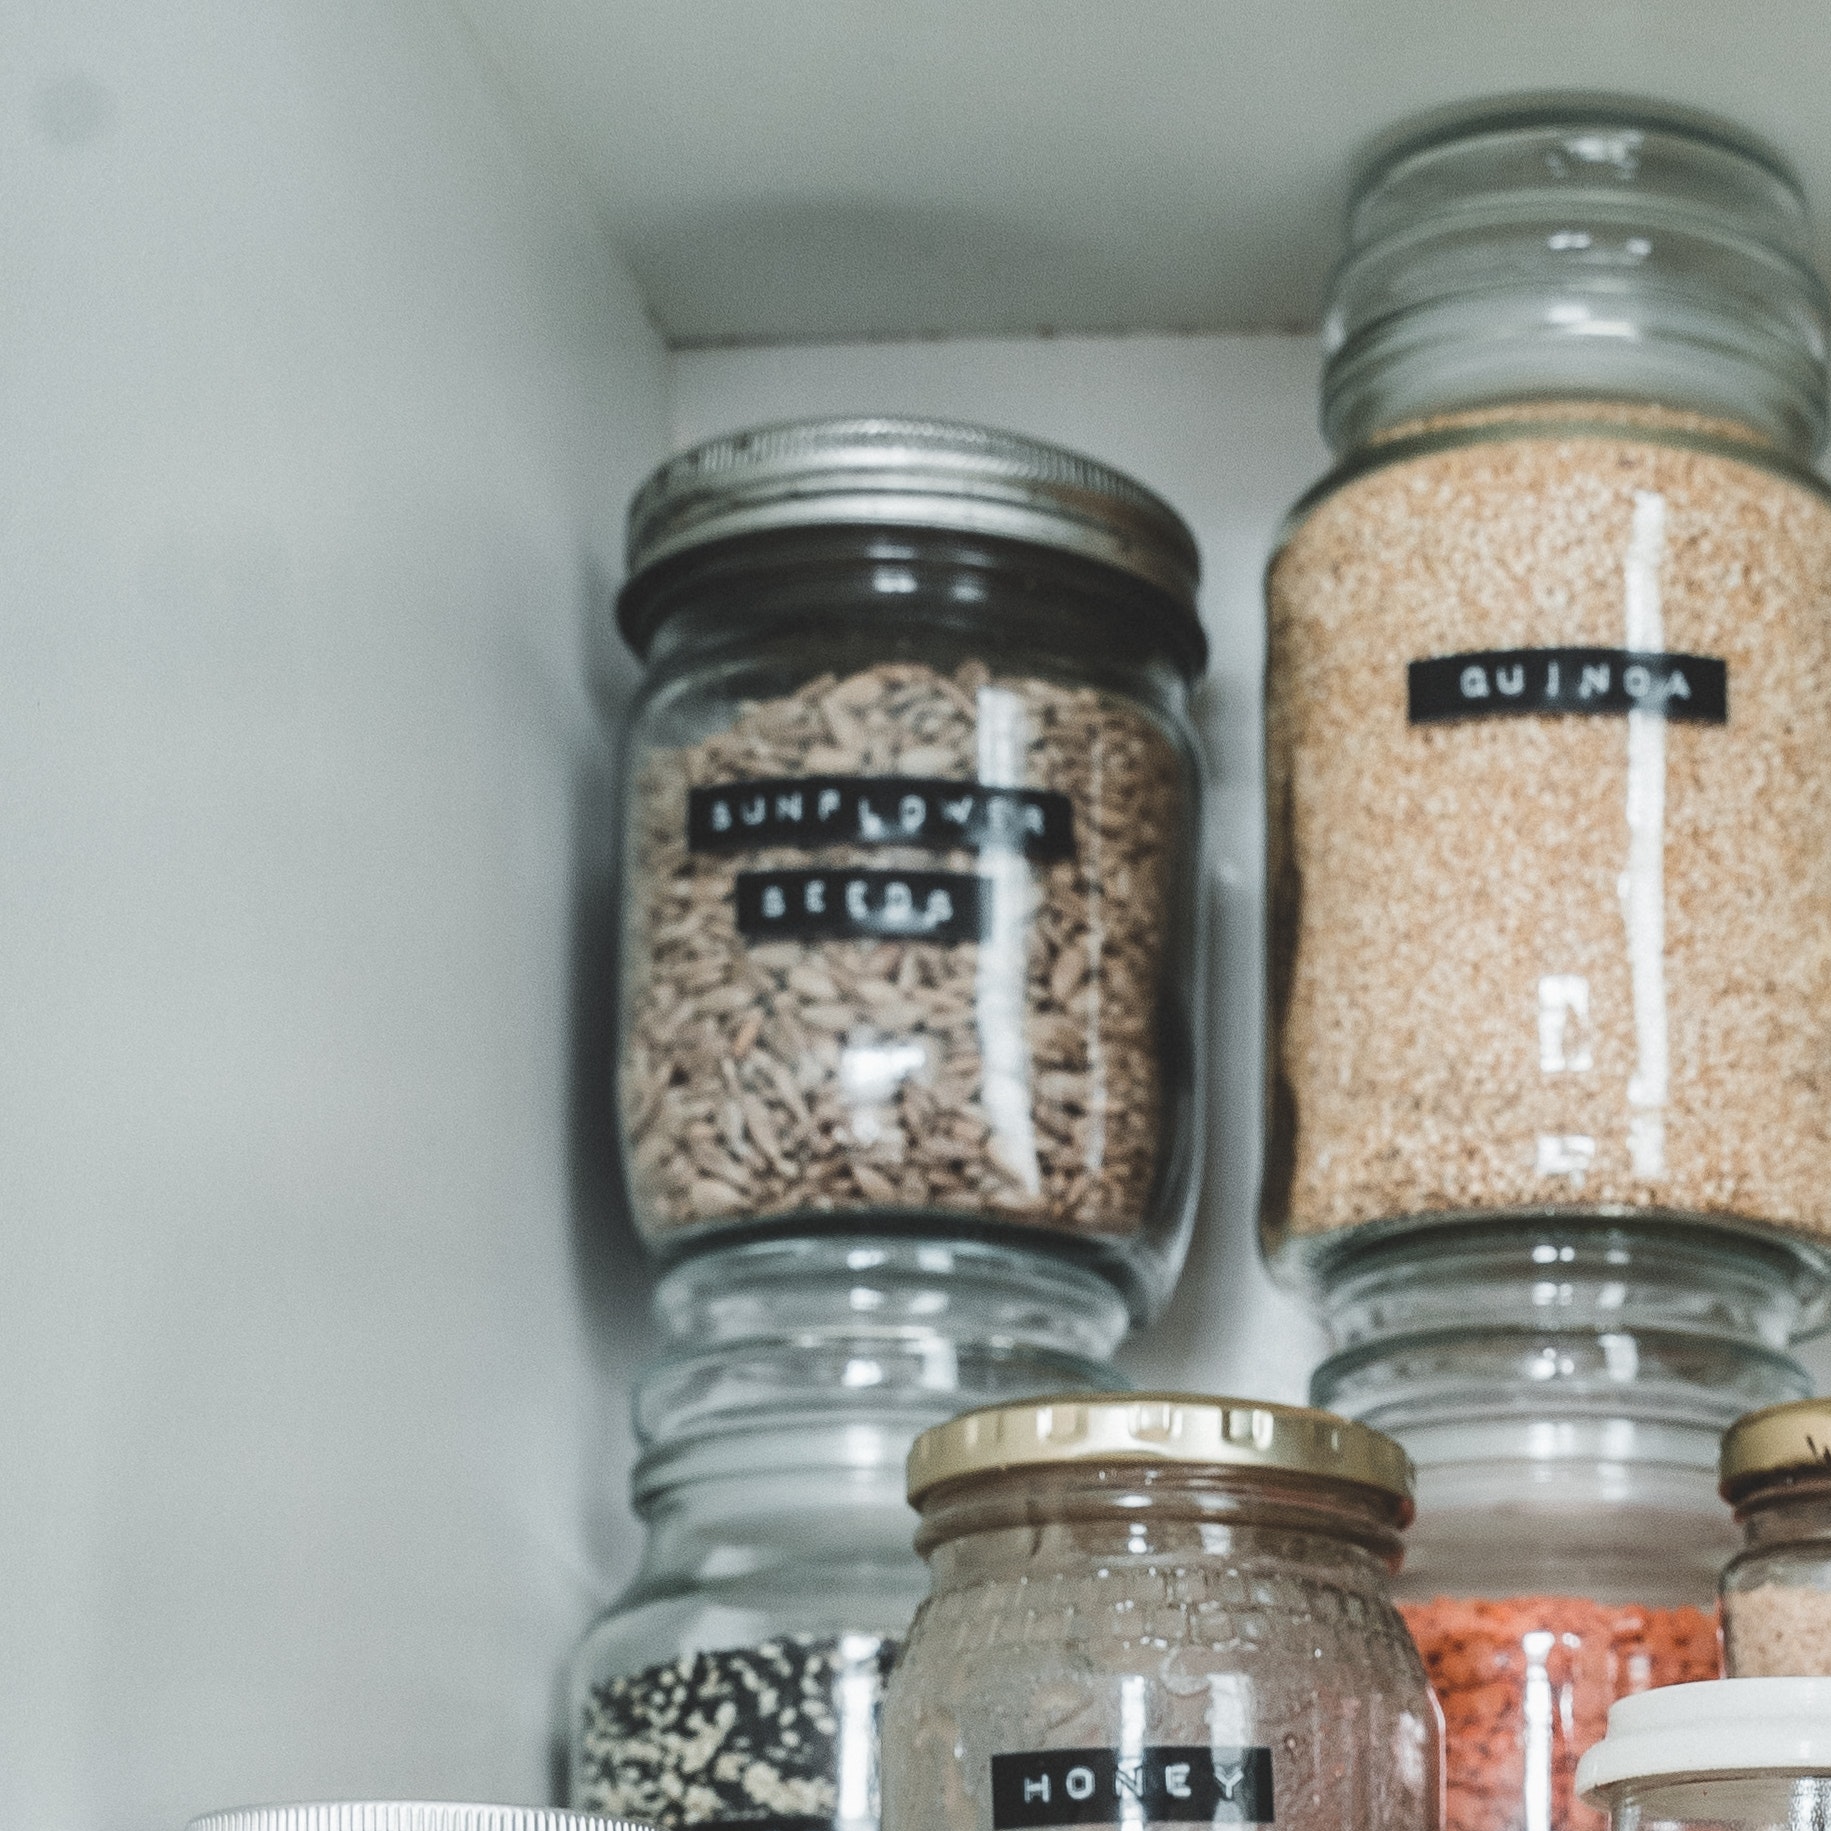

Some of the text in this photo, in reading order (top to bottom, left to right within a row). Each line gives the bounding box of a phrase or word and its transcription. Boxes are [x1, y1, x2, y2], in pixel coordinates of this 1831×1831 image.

[1459, 660, 1692, 701] QUINOA
[762, 879, 954, 926] SEEDS
[1023, 1762, 1245, 1804] HONEY
